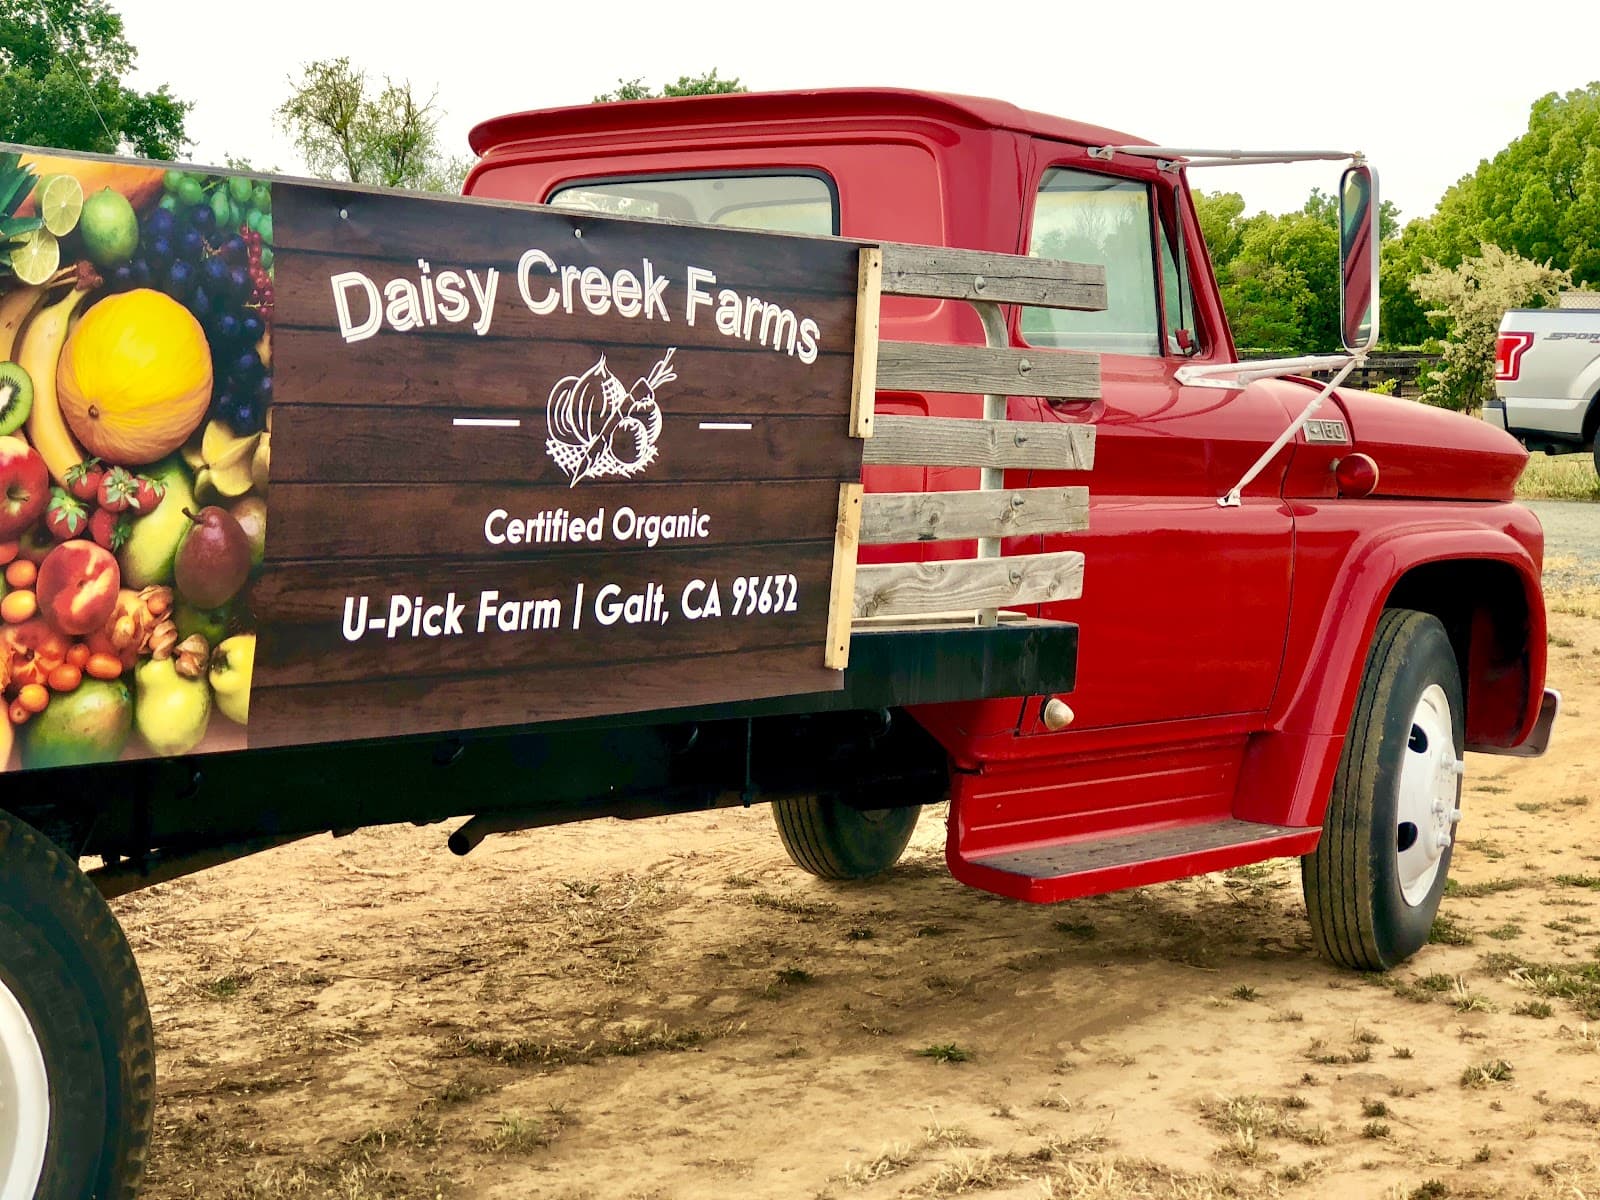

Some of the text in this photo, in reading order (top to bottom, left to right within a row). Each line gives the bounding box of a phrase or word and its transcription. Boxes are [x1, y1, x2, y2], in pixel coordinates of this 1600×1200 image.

[330, 248, 821, 365] Daisy Creek Farms
[484, 506, 711, 548] Certified Organic
[341, 592, 466, 641] U-Pick
[477, 590, 562, 634] Farm
[594, 582, 670, 626] Galt,
[681, 579, 723, 620] CA
[731, 573, 799, 616] 95632
